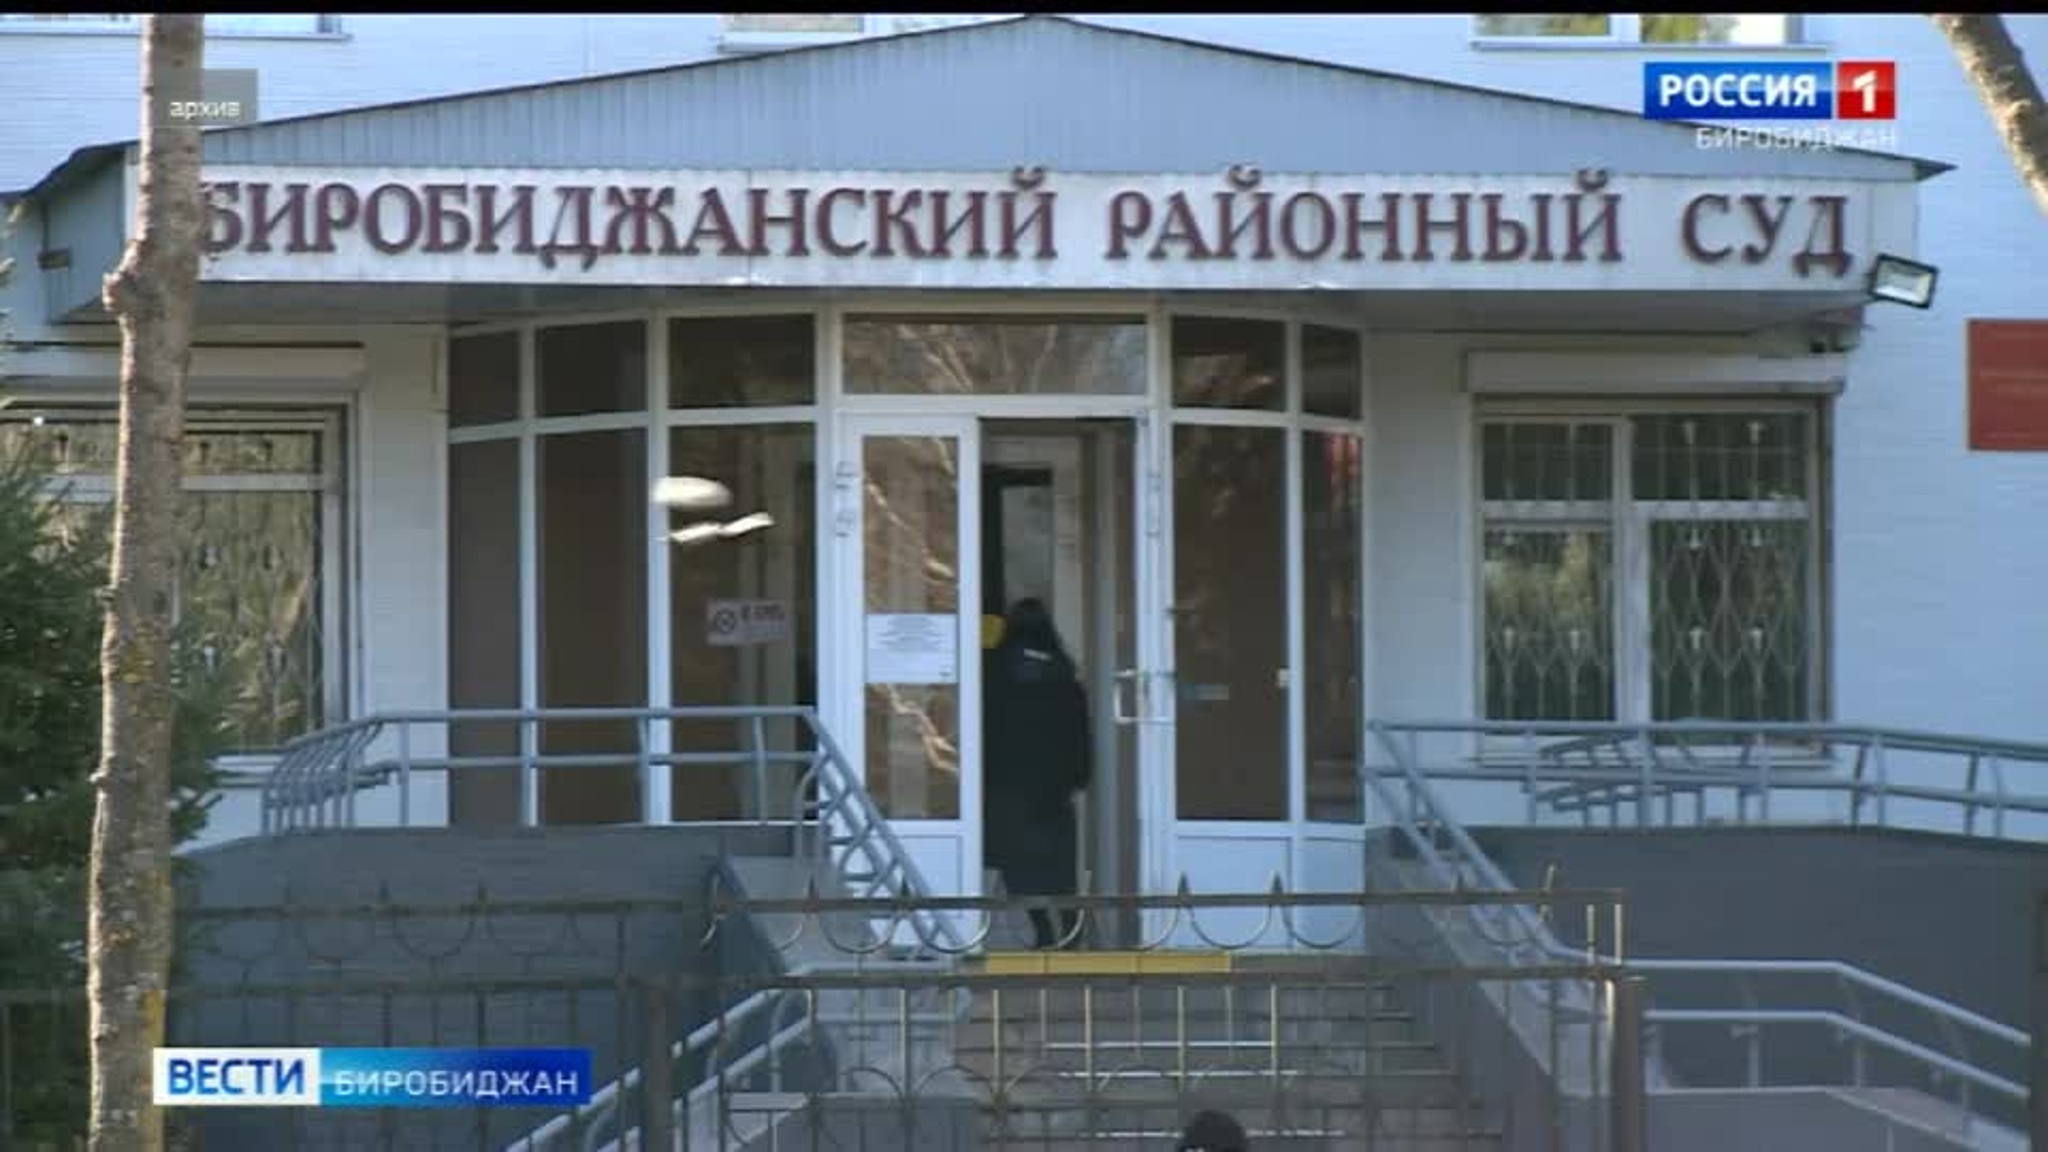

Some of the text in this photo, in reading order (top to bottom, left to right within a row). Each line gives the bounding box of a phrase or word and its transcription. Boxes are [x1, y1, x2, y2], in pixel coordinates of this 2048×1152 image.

[202, 165, 1855, 278] БИРОБИДЖАНСКИЙ РАЙОННЫЙ СУД
